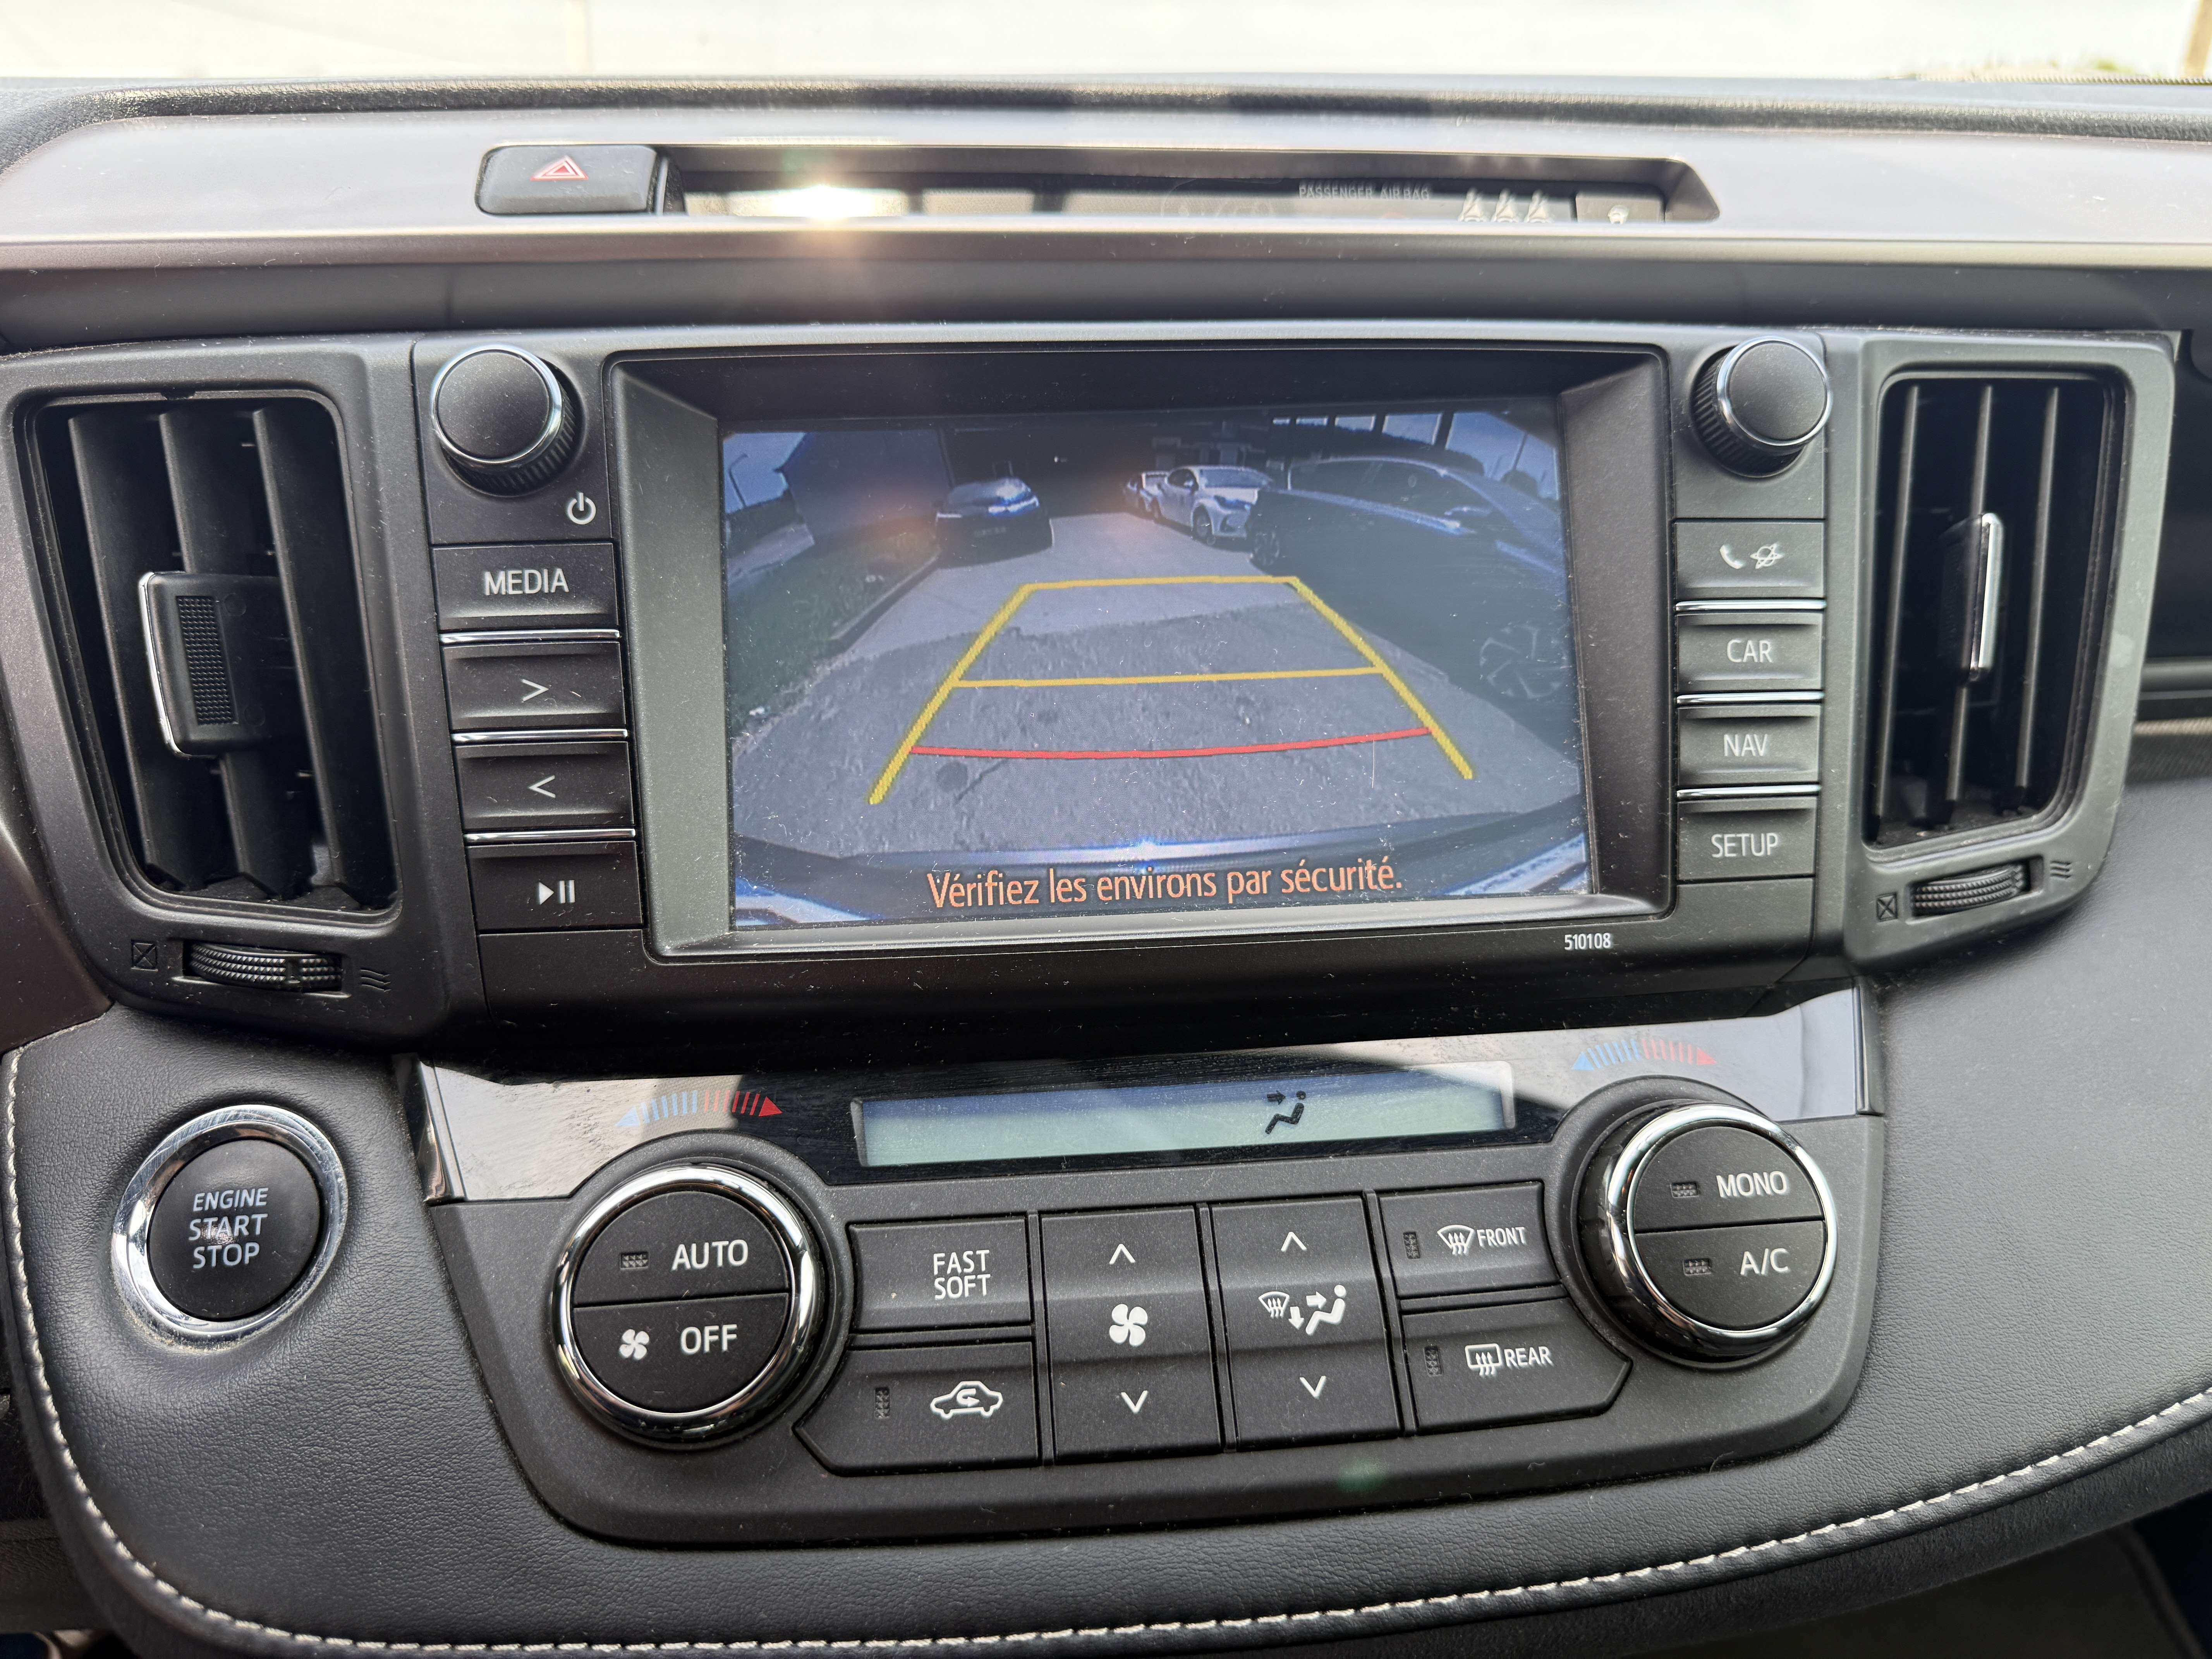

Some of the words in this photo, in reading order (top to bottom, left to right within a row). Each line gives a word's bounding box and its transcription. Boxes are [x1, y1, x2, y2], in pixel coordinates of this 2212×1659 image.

[1298, 185, 1373, 199] PASSENGER
[483, 568, 569, 596] MEDIA
[1726, 639, 1774, 663] CAR
[1723, 733, 1769, 757] NAV
[1711, 832, 1781, 858] SETUP
[927, 870, 1039, 908] Vérifiez
[1049, 869, 1087, 903] les
[1097, 866, 1217, 902] environs
[1227, 871, 1271, 903] par
[1281, 855, 1402, 893] sécurité.
[1564, 932, 1612, 950] 510108
[1716, 1170, 1790, 1198] MONO
[193, 1187, 269, 1212] ENGINE
[188, 1213, 268, 1241] START
[1476, 1226, 1526, 1248] FRONT
[193, 1242, 260, 1269] STOP
[671, 1239, 749, 1271] AUTO
[933, 1249, 990, 1276] FAST
[1740, 1247, 1790, 1276] A/C
[934, 1273, 991, 1300] SOFT
[680, 1324, 738, 1355] OFF
[1503, 1346, 1553, 1368] REAR
